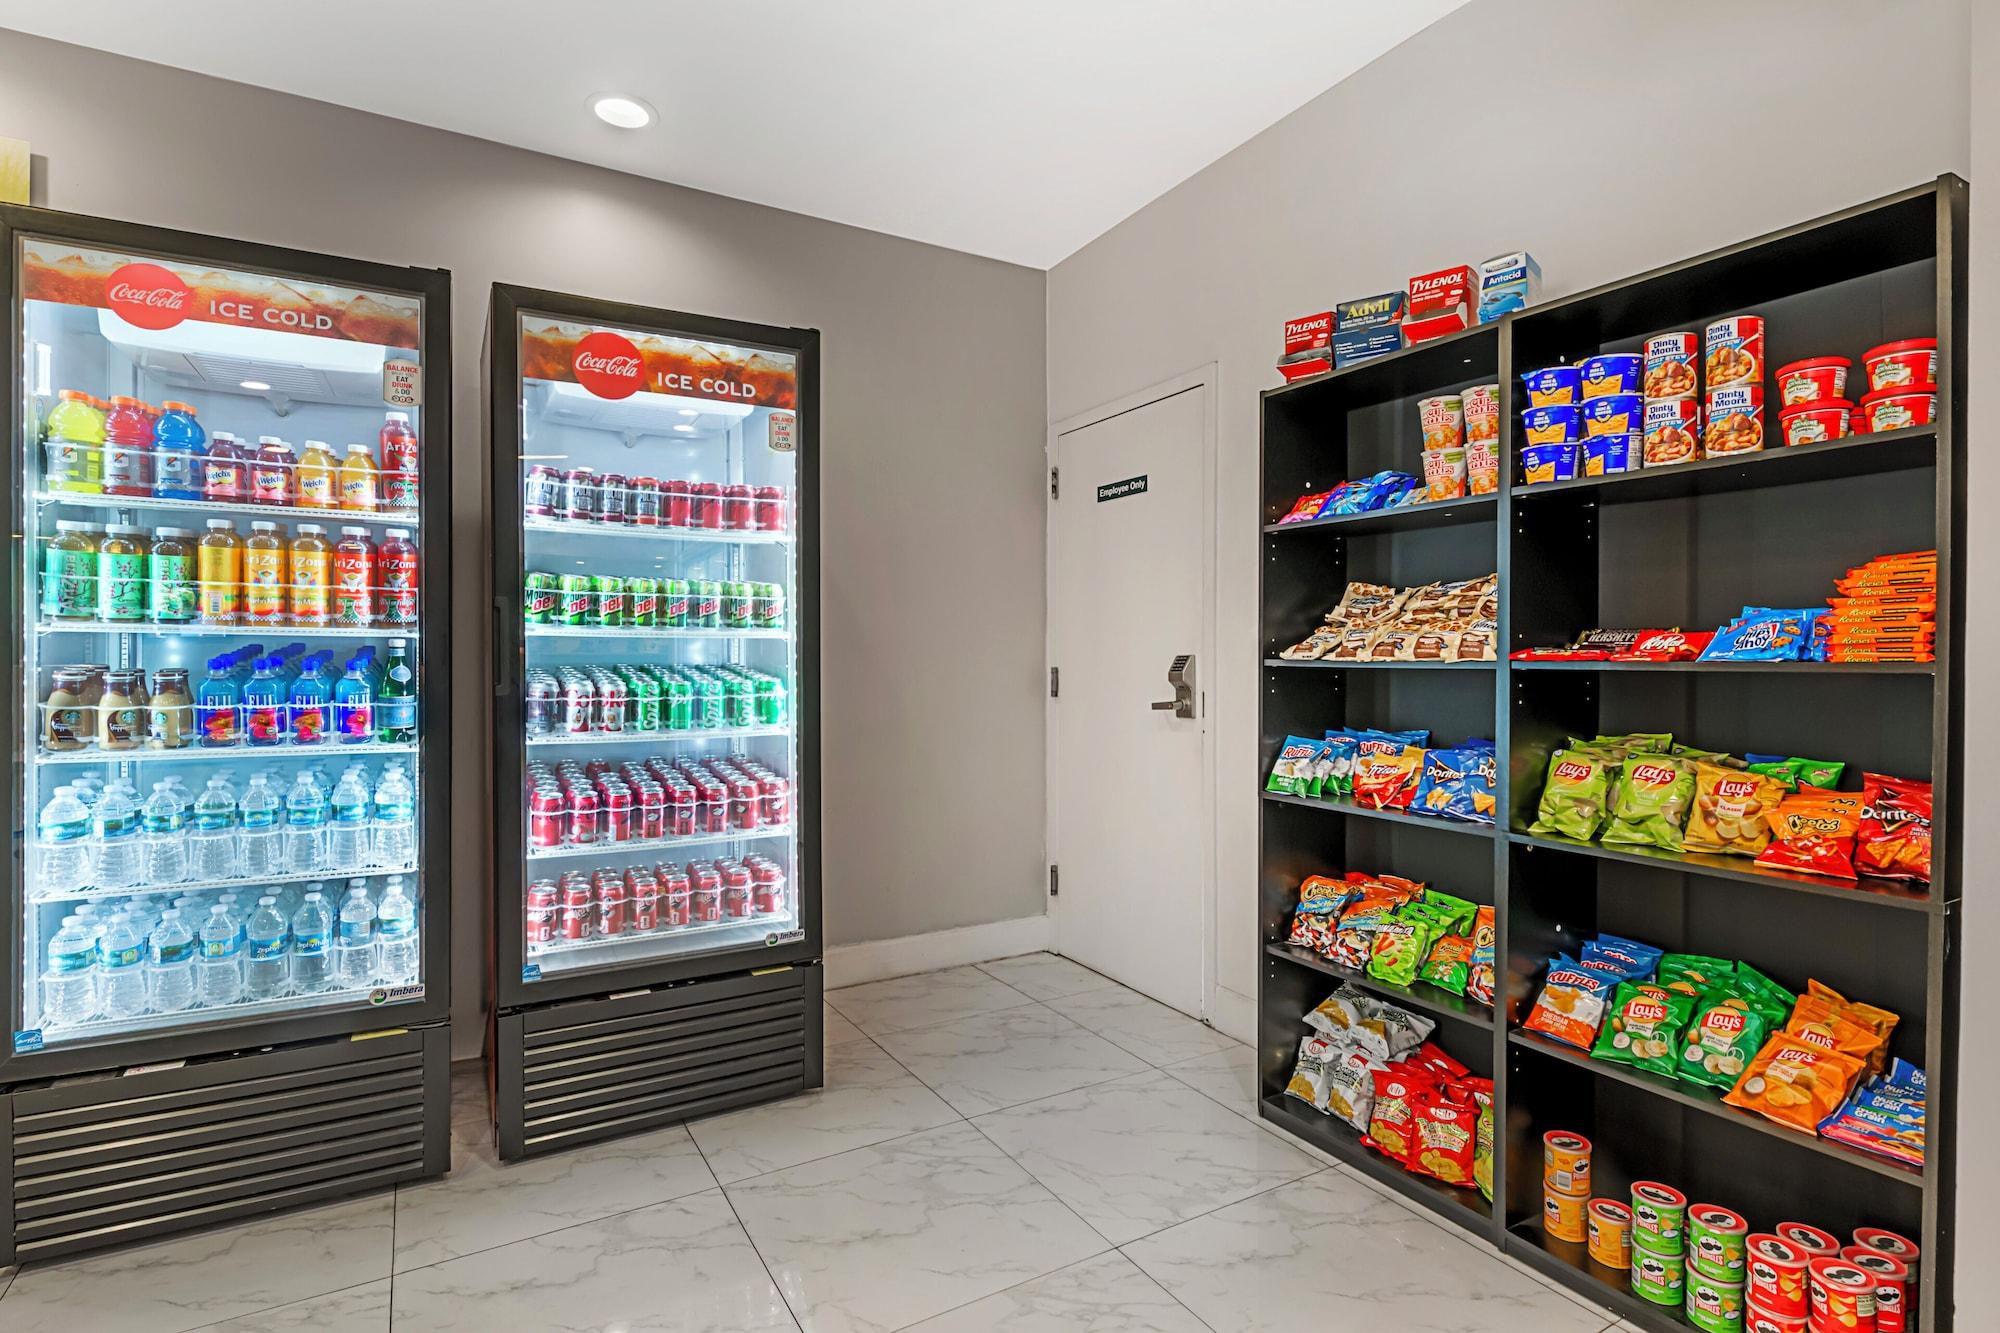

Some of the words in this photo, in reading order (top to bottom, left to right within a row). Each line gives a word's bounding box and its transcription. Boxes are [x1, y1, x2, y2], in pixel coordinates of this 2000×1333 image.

[1411, 272, 1464, 294] TYLENOL
[1489, 270, 1521, 285] Antacid
[110, 283, 189, 310] Coca-Cola
[210, 300, 254, 320] ICE
[263, 308, 333, 330] COLD
[1345, 298, 1390, 319] Advil
[1286, 318, 1329, 336] TYLENOL
[1708, 323, 1730, 335] Dinty
[1653, 338, 1678, 349] Dinty
[1707, 330, 1733, 341] Moore
[1651, 346, 1681, 357] Moore
[575, 352, 641, 377] Coca-Cola
[657, 372, 693, 391] ICE
[700, 378, 756, 398] COLD
[1471, 397, 1491, 407] CUP
[1715, 397, 1747, 408] Moore
[1717, 390, 1744, 400] Dinty
[1428, 408, 1446, 417] CUP
[1648, 411, 1676, 421] Moore
[1650, 404, 1673, 414] Dinty
[1099, 484, 1129, 498] Employee
[1129, 480, 1146, 490] Only
[1426, 766, 1466, 778] Doritos
[1556, 762, 1590, 779] Lay's
[1633, 765, 1675, 785] Lay's
[1718, 780, 1753, 799] Lay's
[1860, 805, 1931, 827] Doritos
[779, 930, 804, 940] Imbera
[1548, 971, 1600, 993] RUFFLES
[389, 985, 424, 997] Imbera
[1629, 1001, 1663, 1019] Lay's
[1707, 1011, 1742, 1031] Lay's
[1800, 1029, 1834, 1049] Lay's
[1775, 1048, 1817, 1063] Lay's
[1871, 1101, 1901, 1112] Grain
